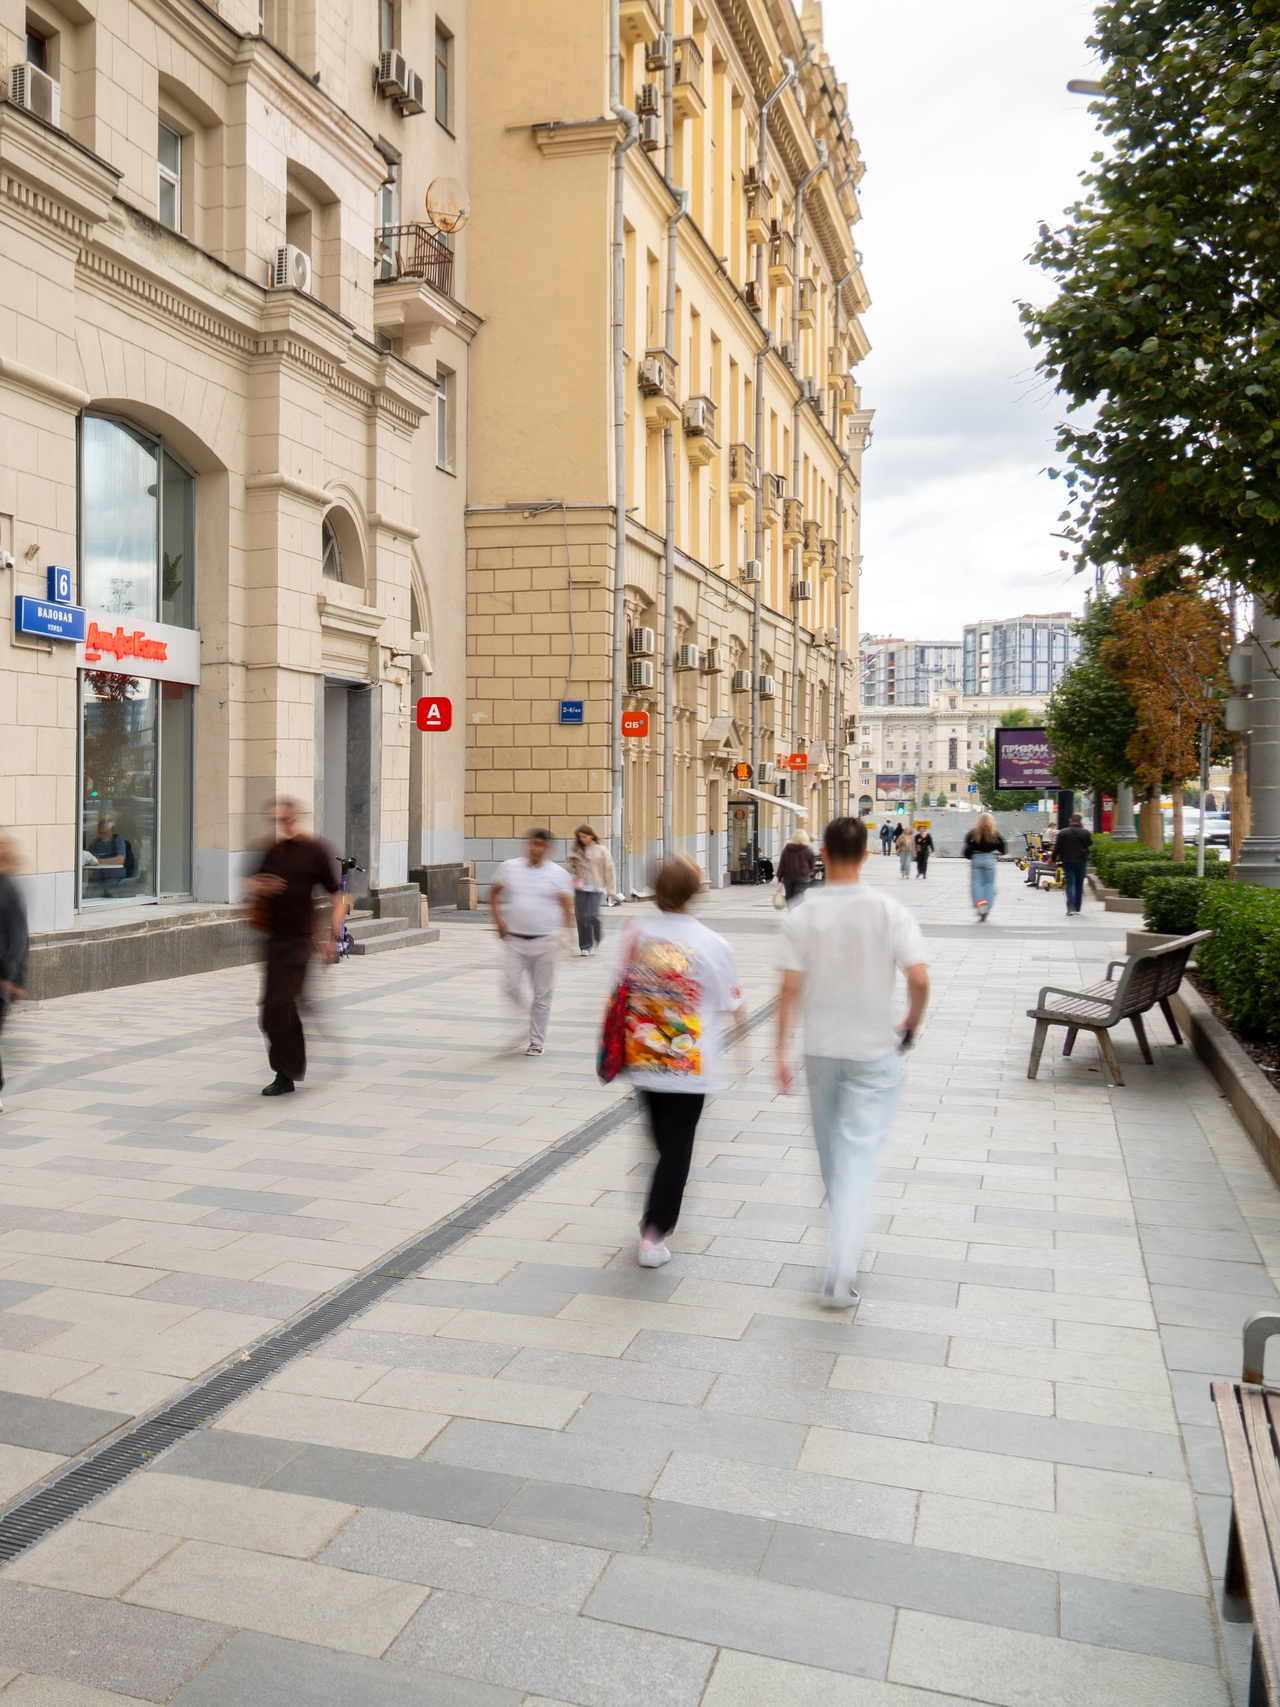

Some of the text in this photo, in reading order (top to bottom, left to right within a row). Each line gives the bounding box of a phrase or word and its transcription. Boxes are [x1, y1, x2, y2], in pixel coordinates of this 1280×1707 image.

[59, 574, 68, 597] 6
[37, 607, 73, 623] ВАЛОВАЯ
[47, 623, 63, 633] УЛИЦА
[1001, 744, 1049, 752] ПРИЗРАК
